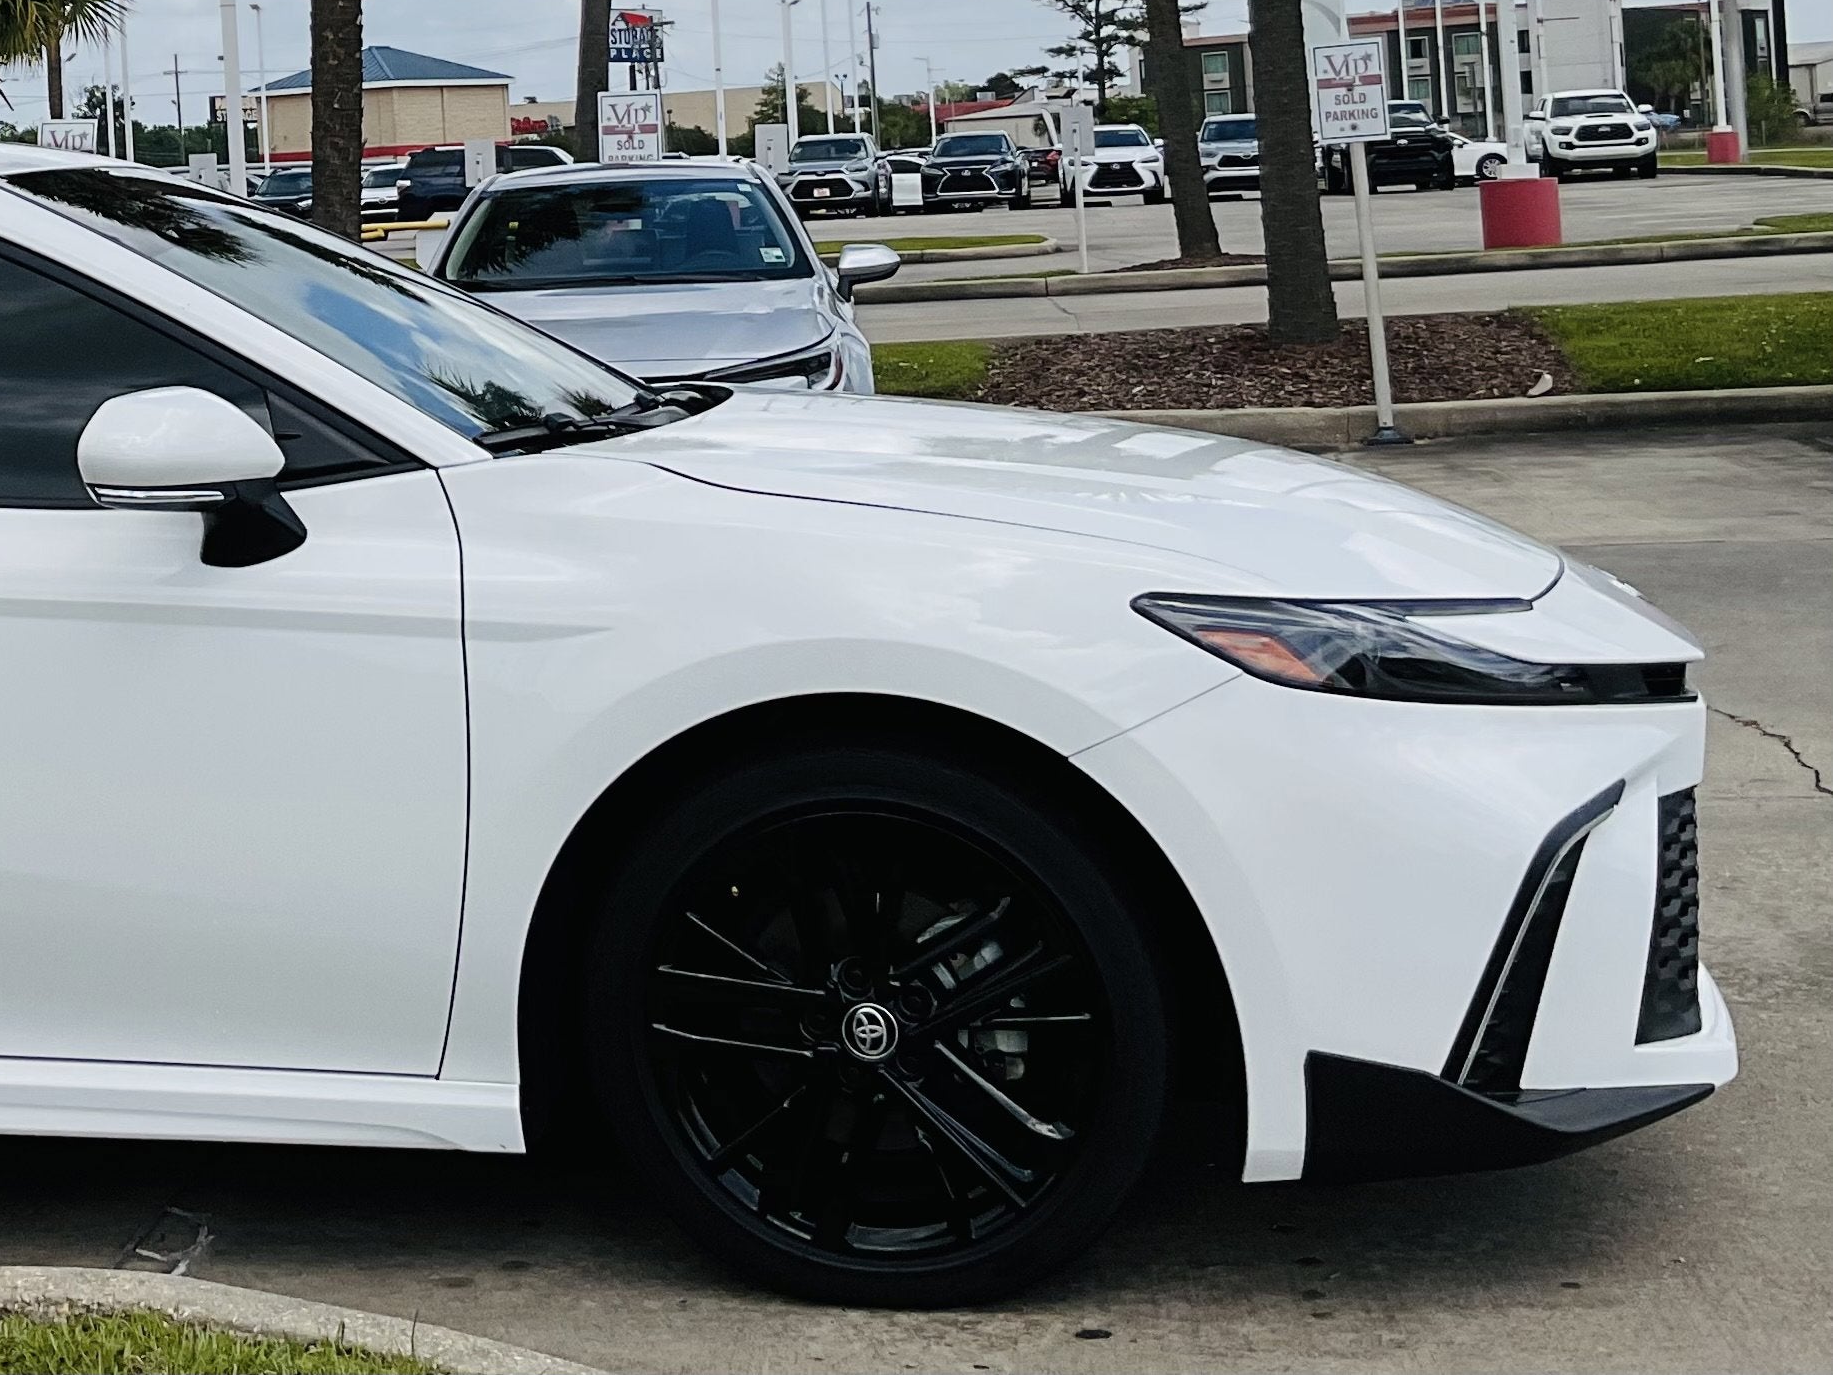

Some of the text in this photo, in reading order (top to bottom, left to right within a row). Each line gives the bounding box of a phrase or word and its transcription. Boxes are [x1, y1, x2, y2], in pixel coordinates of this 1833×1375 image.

[610, 48, 662, 60] PLACE
[1334, 92, 1367, 106] SOLD
[1325, 108, 1379, 122] PARKING
[617, 139, 645, 151] SOLD
